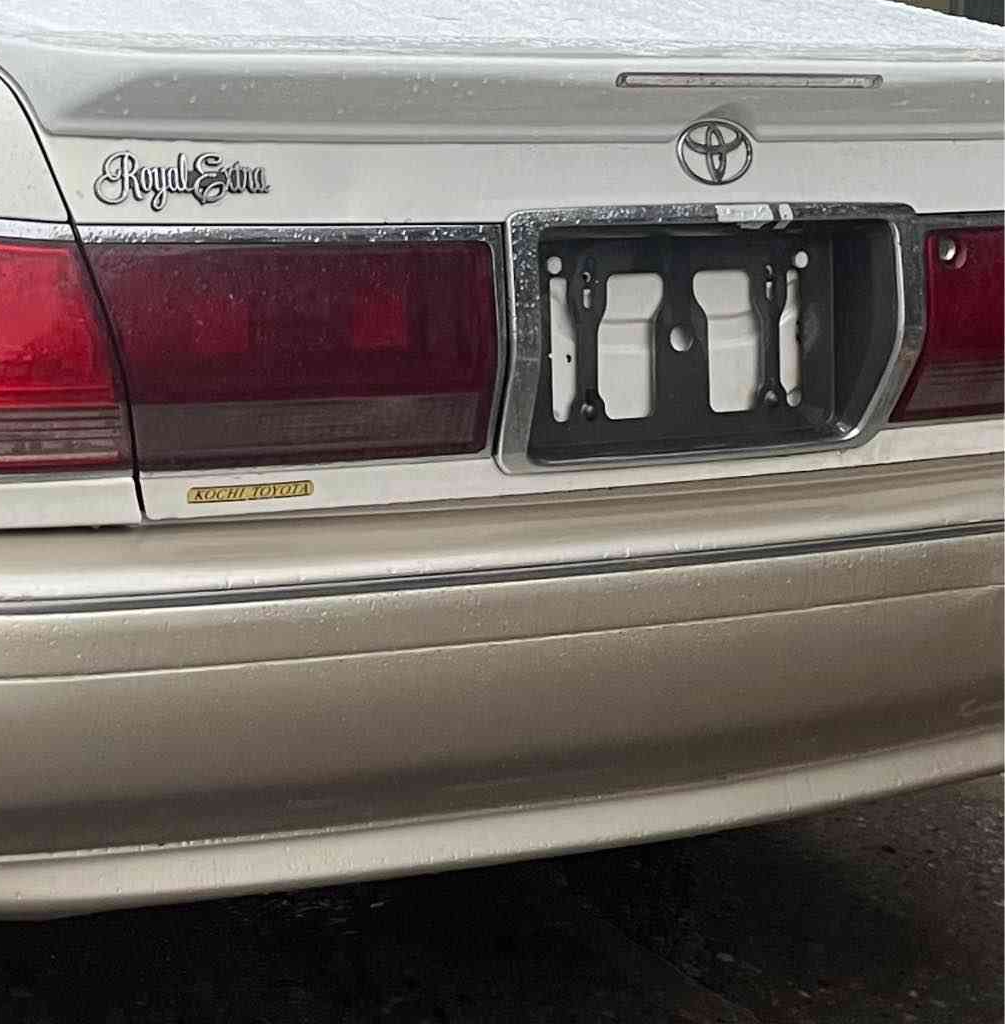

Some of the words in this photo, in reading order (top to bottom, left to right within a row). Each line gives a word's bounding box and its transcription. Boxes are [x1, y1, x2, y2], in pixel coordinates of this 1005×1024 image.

[94, 150, 191, 212] Royal
[191, 152, 271, 206] Extra
[194, 487, 246, 501] KOCHI
[250, 482, 309, 498] TOYOTA
